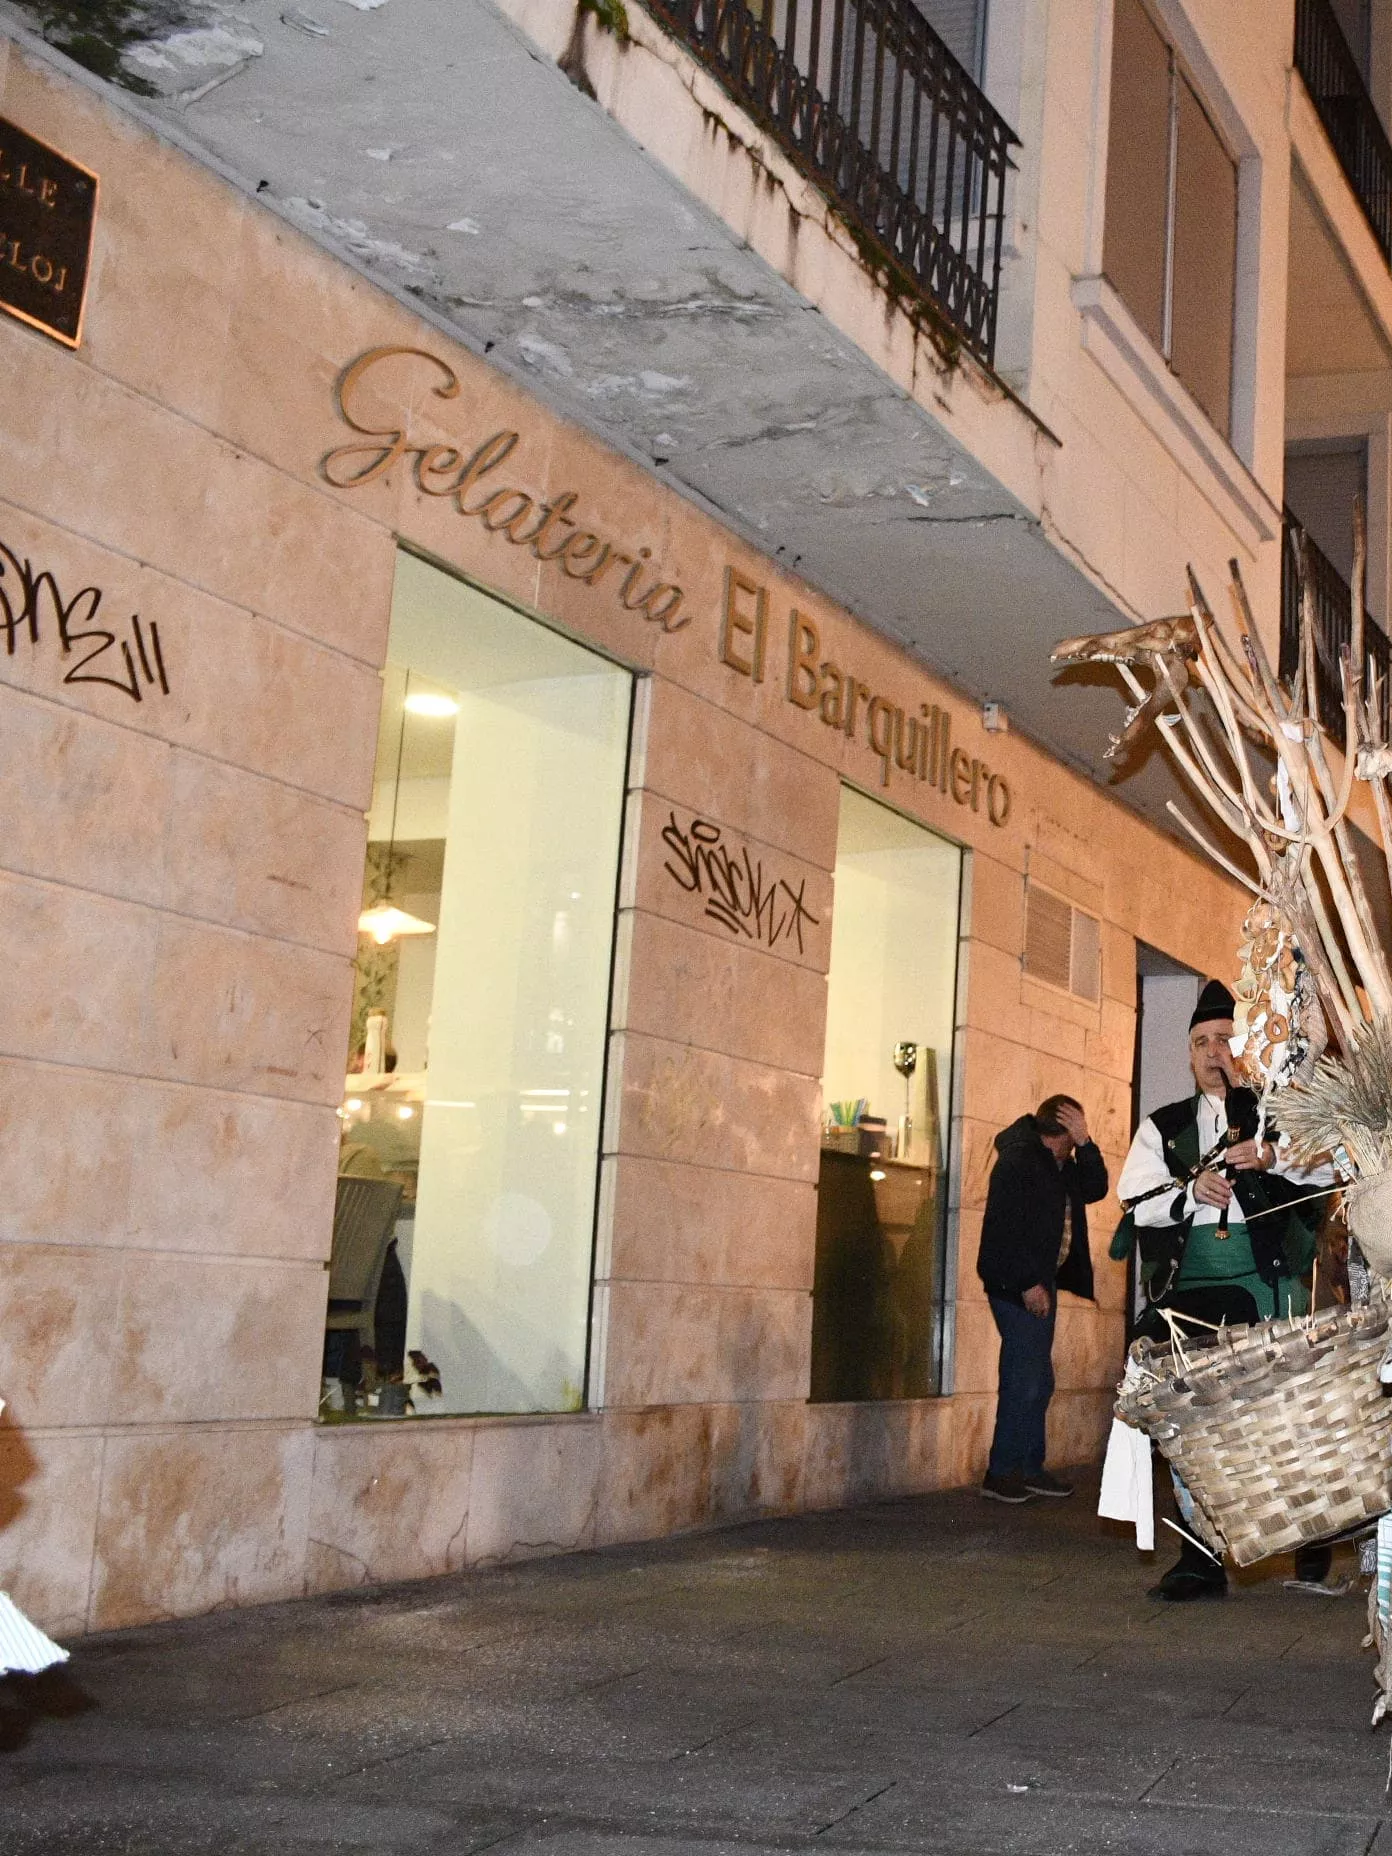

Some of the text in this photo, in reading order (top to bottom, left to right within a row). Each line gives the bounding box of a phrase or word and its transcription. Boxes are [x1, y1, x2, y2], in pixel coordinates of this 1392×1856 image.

[318, 343, 691, 635] Gelateria
[718, 565, 1012, 828] El Barquillero
